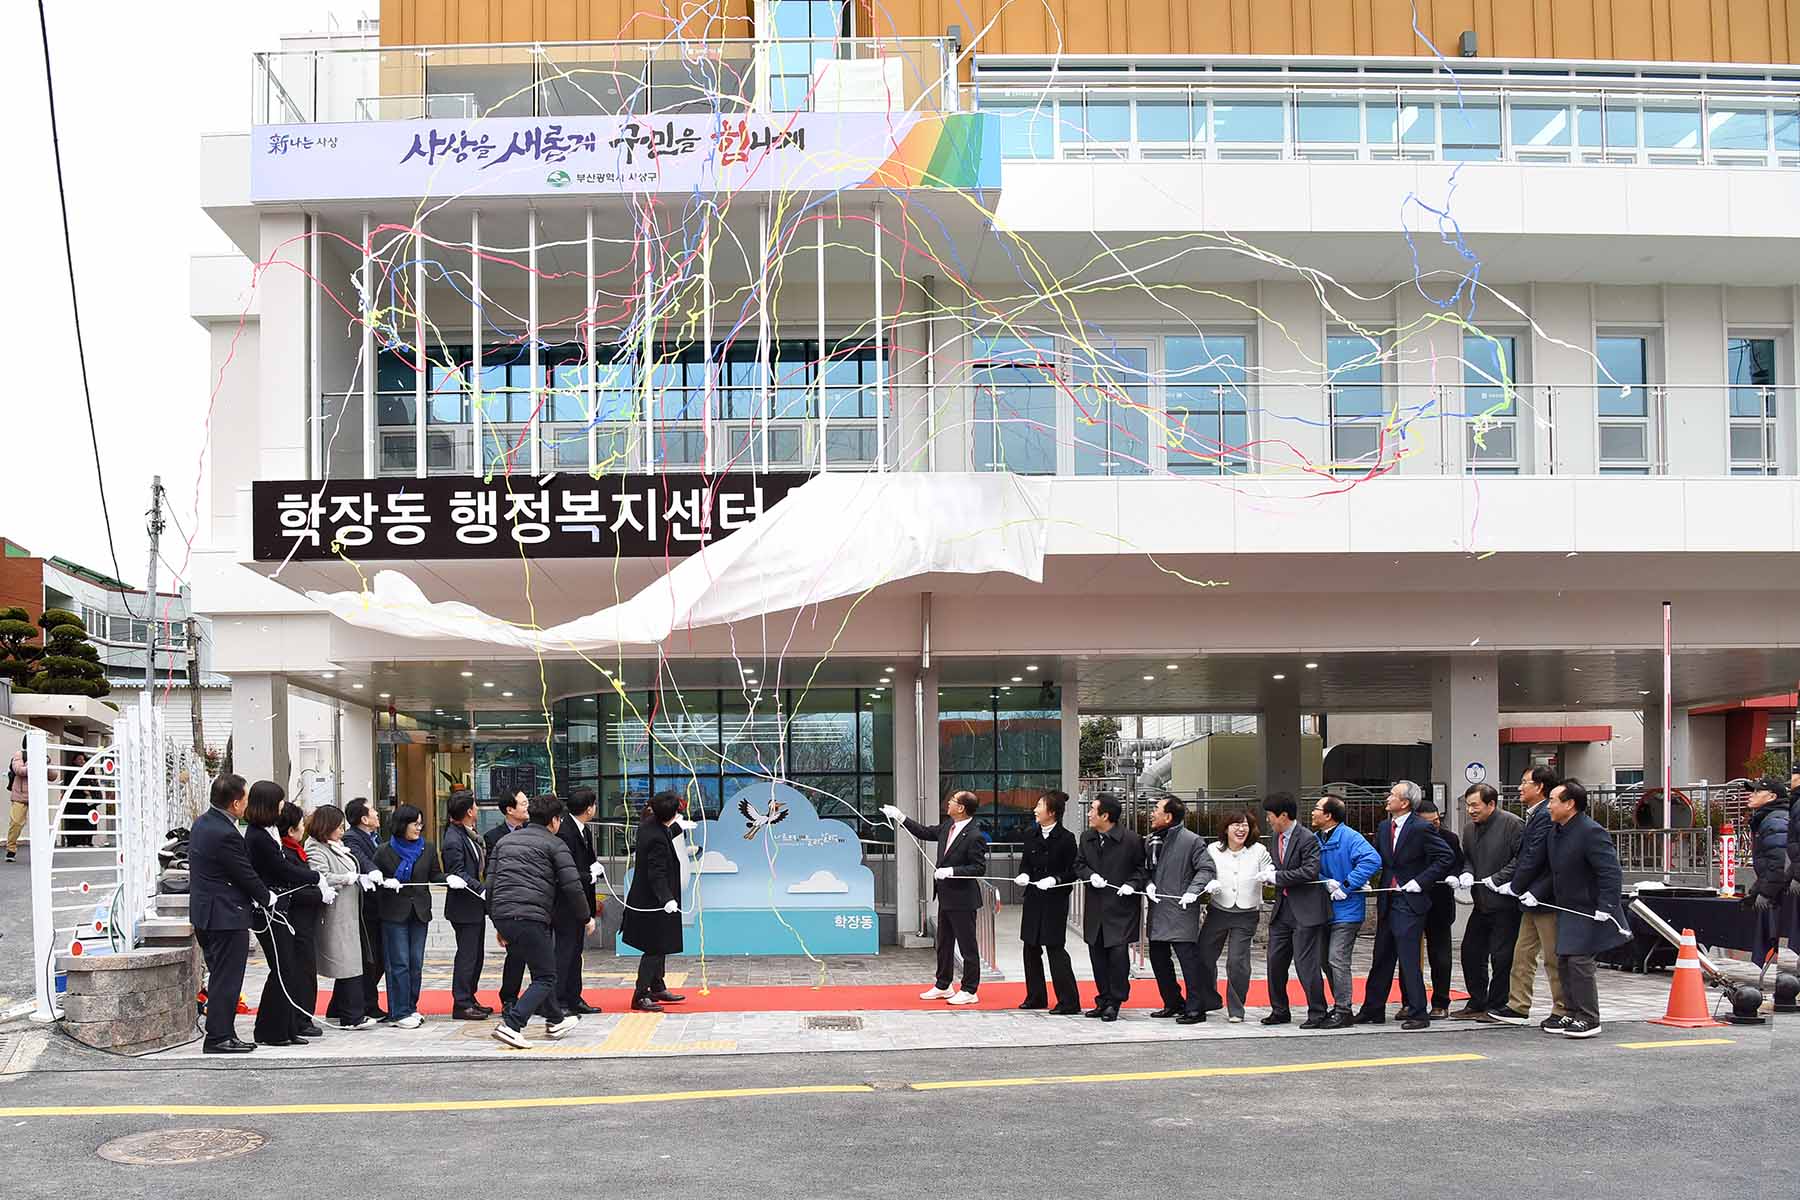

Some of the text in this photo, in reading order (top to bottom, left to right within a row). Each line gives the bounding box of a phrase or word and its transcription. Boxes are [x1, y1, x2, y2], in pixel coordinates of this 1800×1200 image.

[267, 133, 338, 155] 新나는 사상
[400, 119, 805, 170] 사상을 새롭게 구민을 힘나게
[576, 172, 657, 184] 부산광역시 사상구
[277, 486, 764, 547] 학장동 행정복지센터
[834, 914, 873, 929] 학장동
